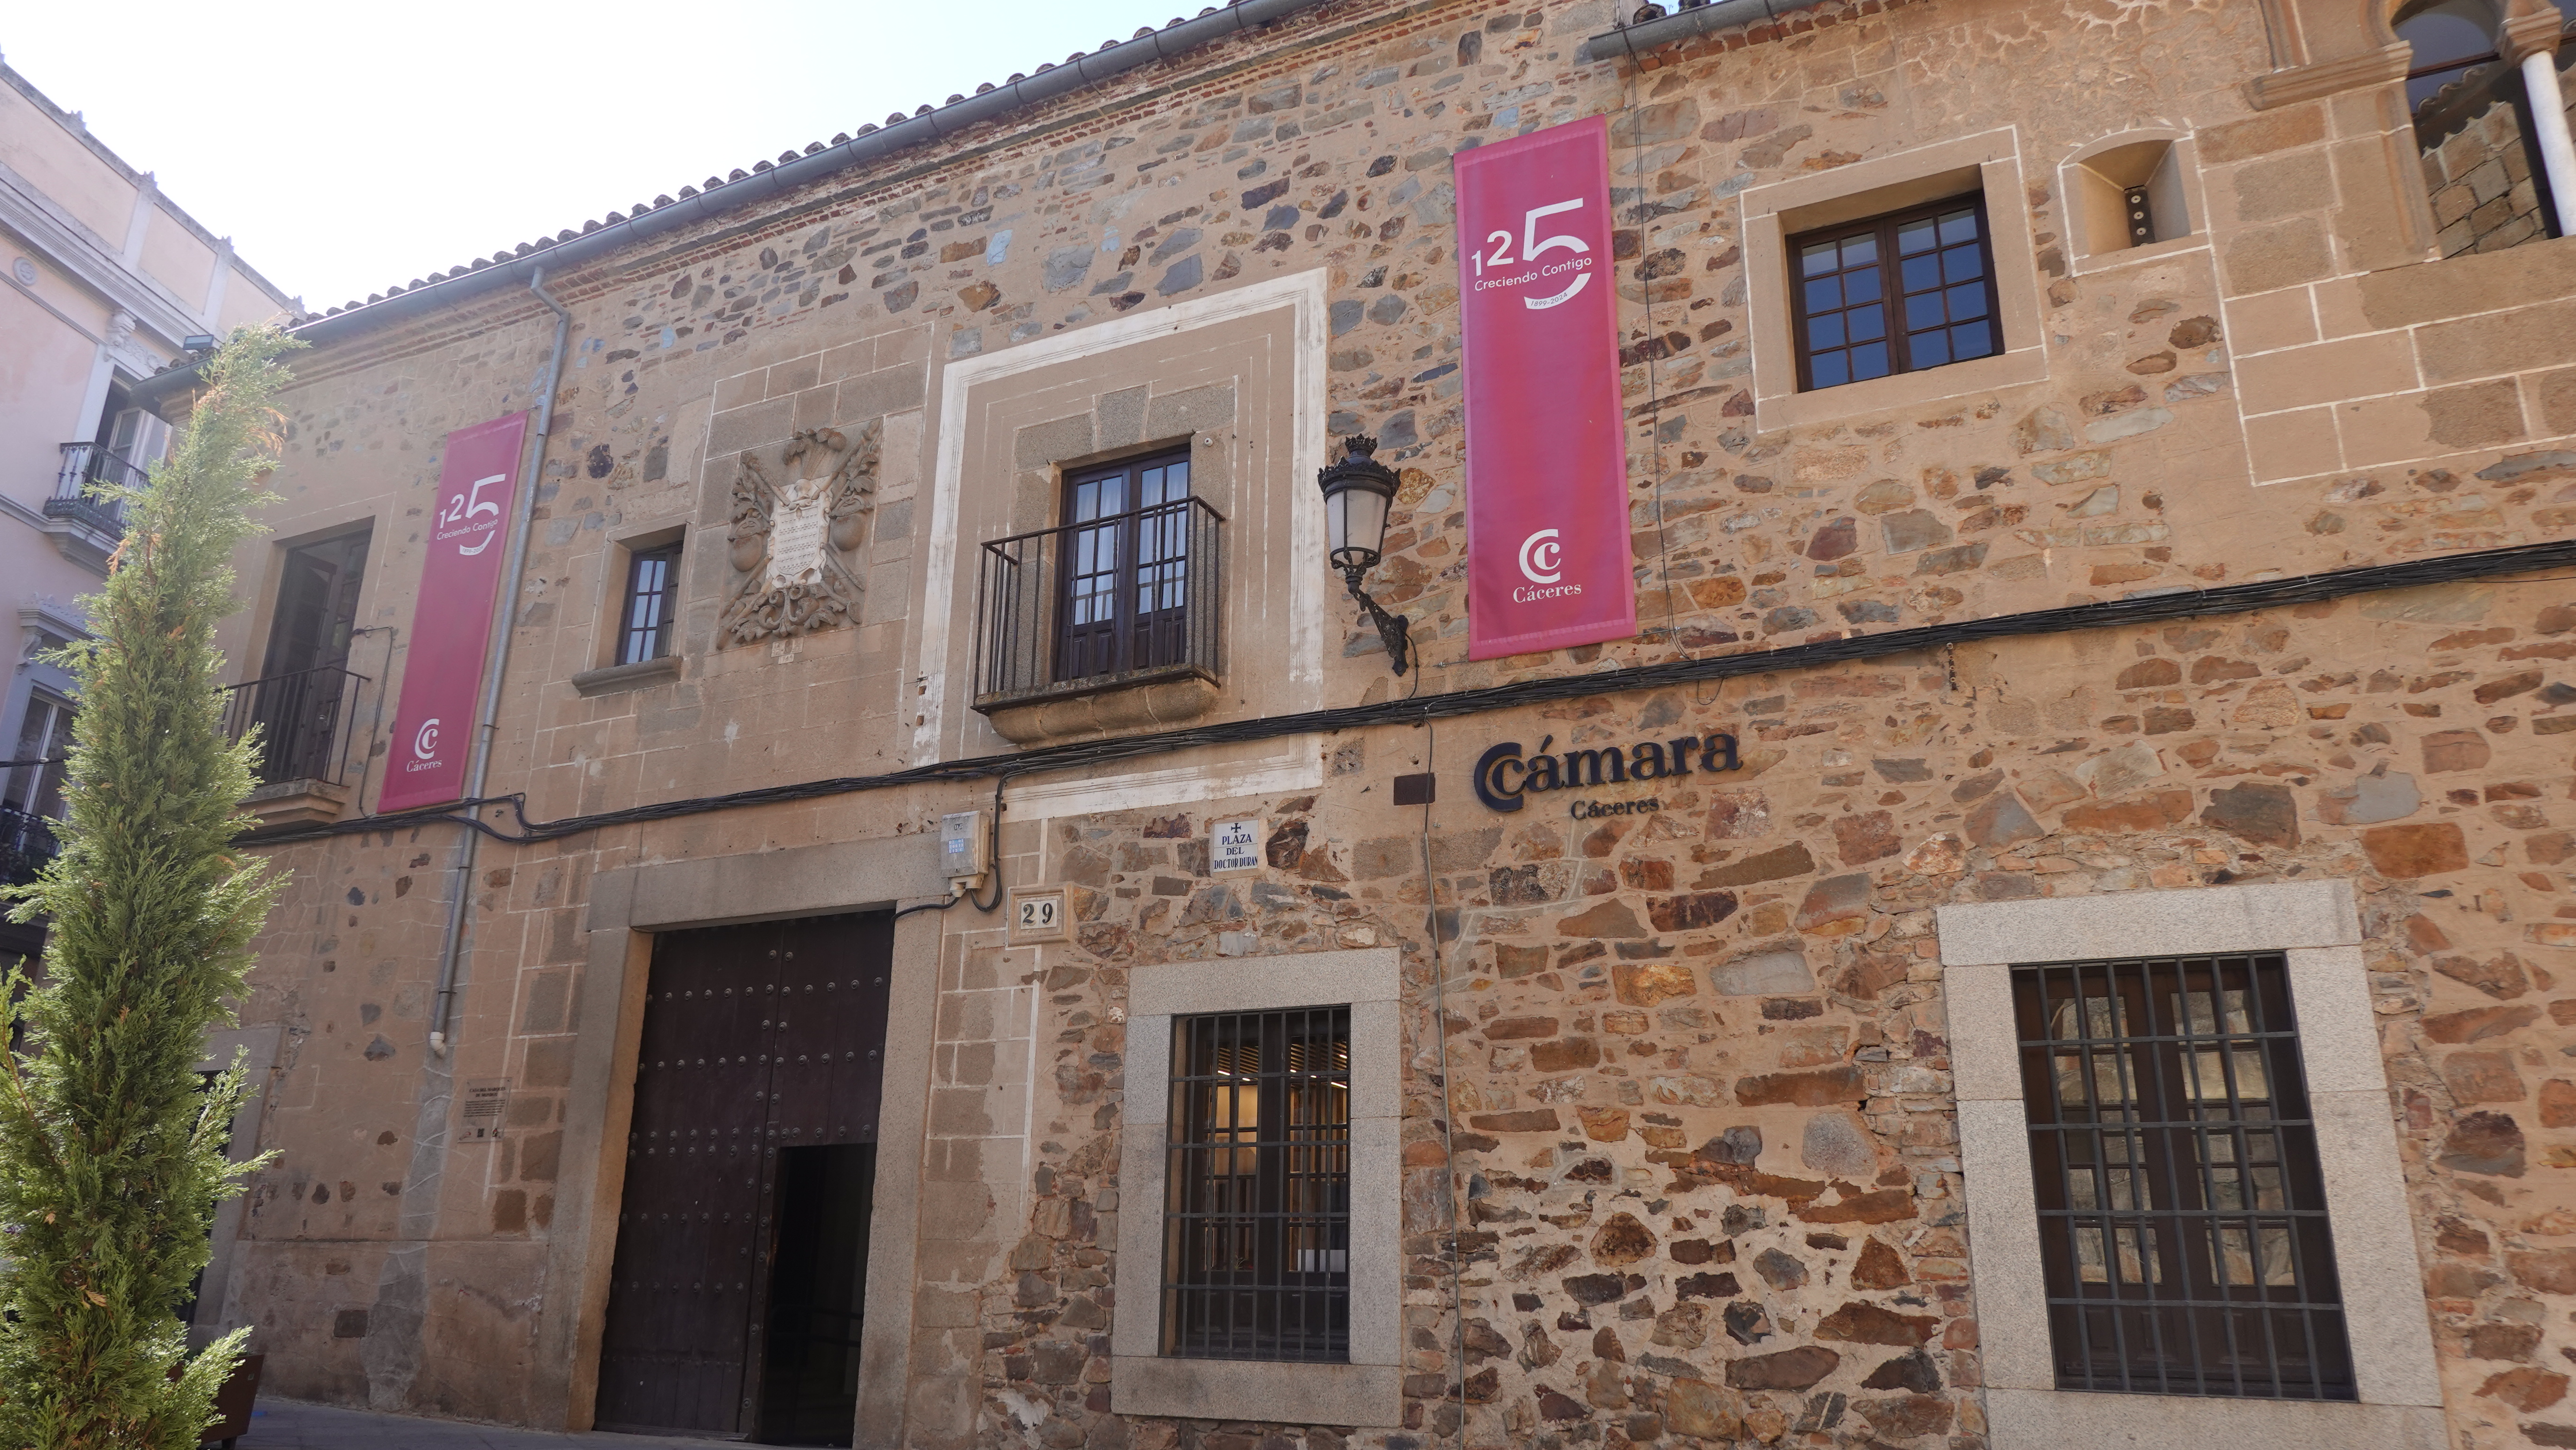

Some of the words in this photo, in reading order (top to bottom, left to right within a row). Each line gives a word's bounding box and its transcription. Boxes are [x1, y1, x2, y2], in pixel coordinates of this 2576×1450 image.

[1471, 197, 1592, 310] 125
[1474, 271, 1538, 291] Creciendo
[1542, 257, 1592, 277] Contigo
[1530, 292, 1568, 307] 1899-2024
[439, 473, 506, 556] 125
[437, 525, 471, 540] Creciendo
[473, 519, 498, 532] Contigo
[1513, 584, 1582, 603] Cáceres
[406, 760, 443, 772] Cáceres
[1570, 798, 1660, 820] Cáceres
[1222, 834, 1252, 845] PLAZA
[1226, 847, 1245, 855] DEL
[1214, 858, 1239, 869] DOCTOR
[1239, 856, 1258, 867] DURAN
[1022, 902, 1054, 925] 29
